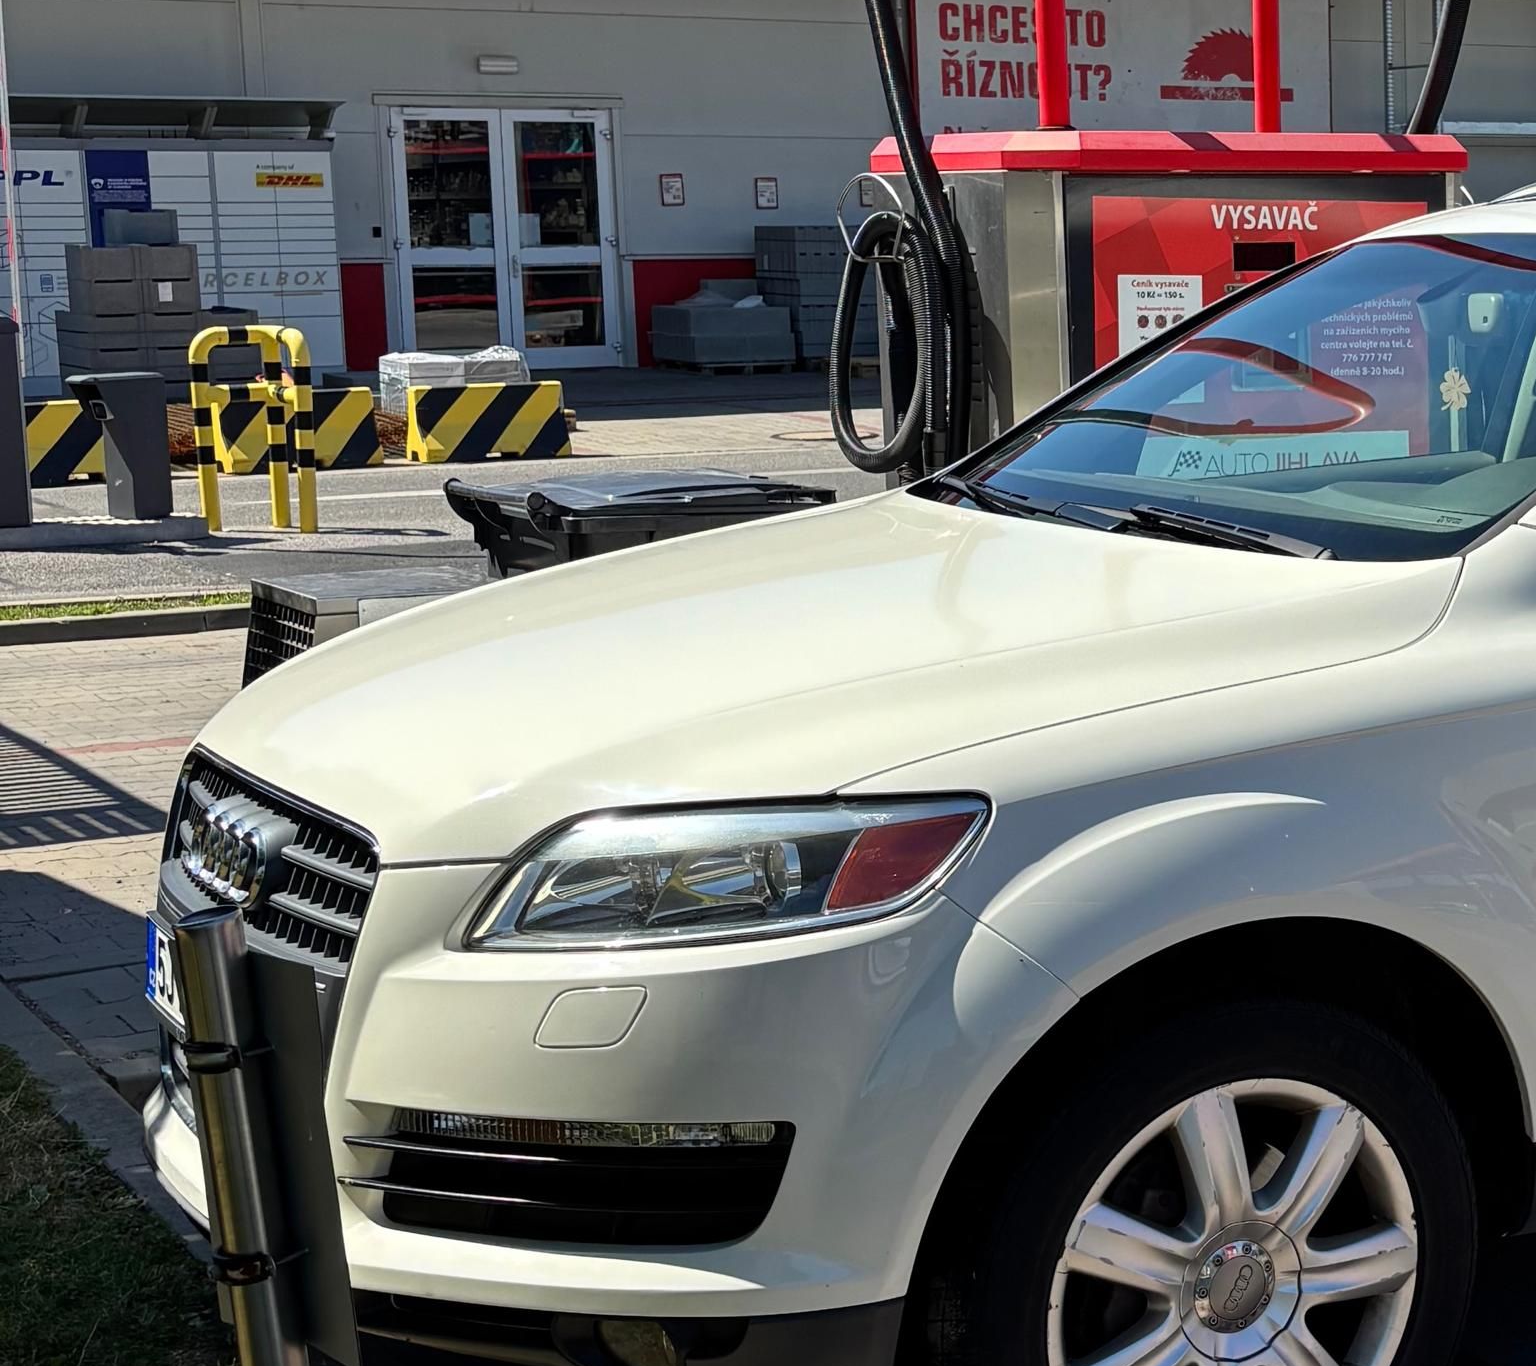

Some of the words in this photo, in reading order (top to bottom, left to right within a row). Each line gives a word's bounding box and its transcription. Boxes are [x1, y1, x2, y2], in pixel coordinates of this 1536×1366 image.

[938, 2, 1038, 44] CHCE
[0, 170, 64, 186] PL
[264, 175, 314, 186] DHL
[1211, 201, 1318, 231] VYSAVAČ
[1136, 291, 1146, 299] 10
[1164, 291, 1177, 299] 150
[1364, 298, 1412, 310] jakýchkoliv
[1372, 310, 1414, 323] problémů
[1323, 327, 1335, 336] na
[1320, 339, 1348, 349] centra
[1349, 338, 1378, 350] volejte
[1379, 340, 1390, 348] na
[1391, 338, 1406, 348] tel.
[1342, 353, 1358, 362] 776
[1360, 352, 1375, 362] 777
[1362, 366, 1381, 376] 8-20
[1382, 366, 1405, 376] hod.)
[1204, 452, 1270, 477] AUTO
